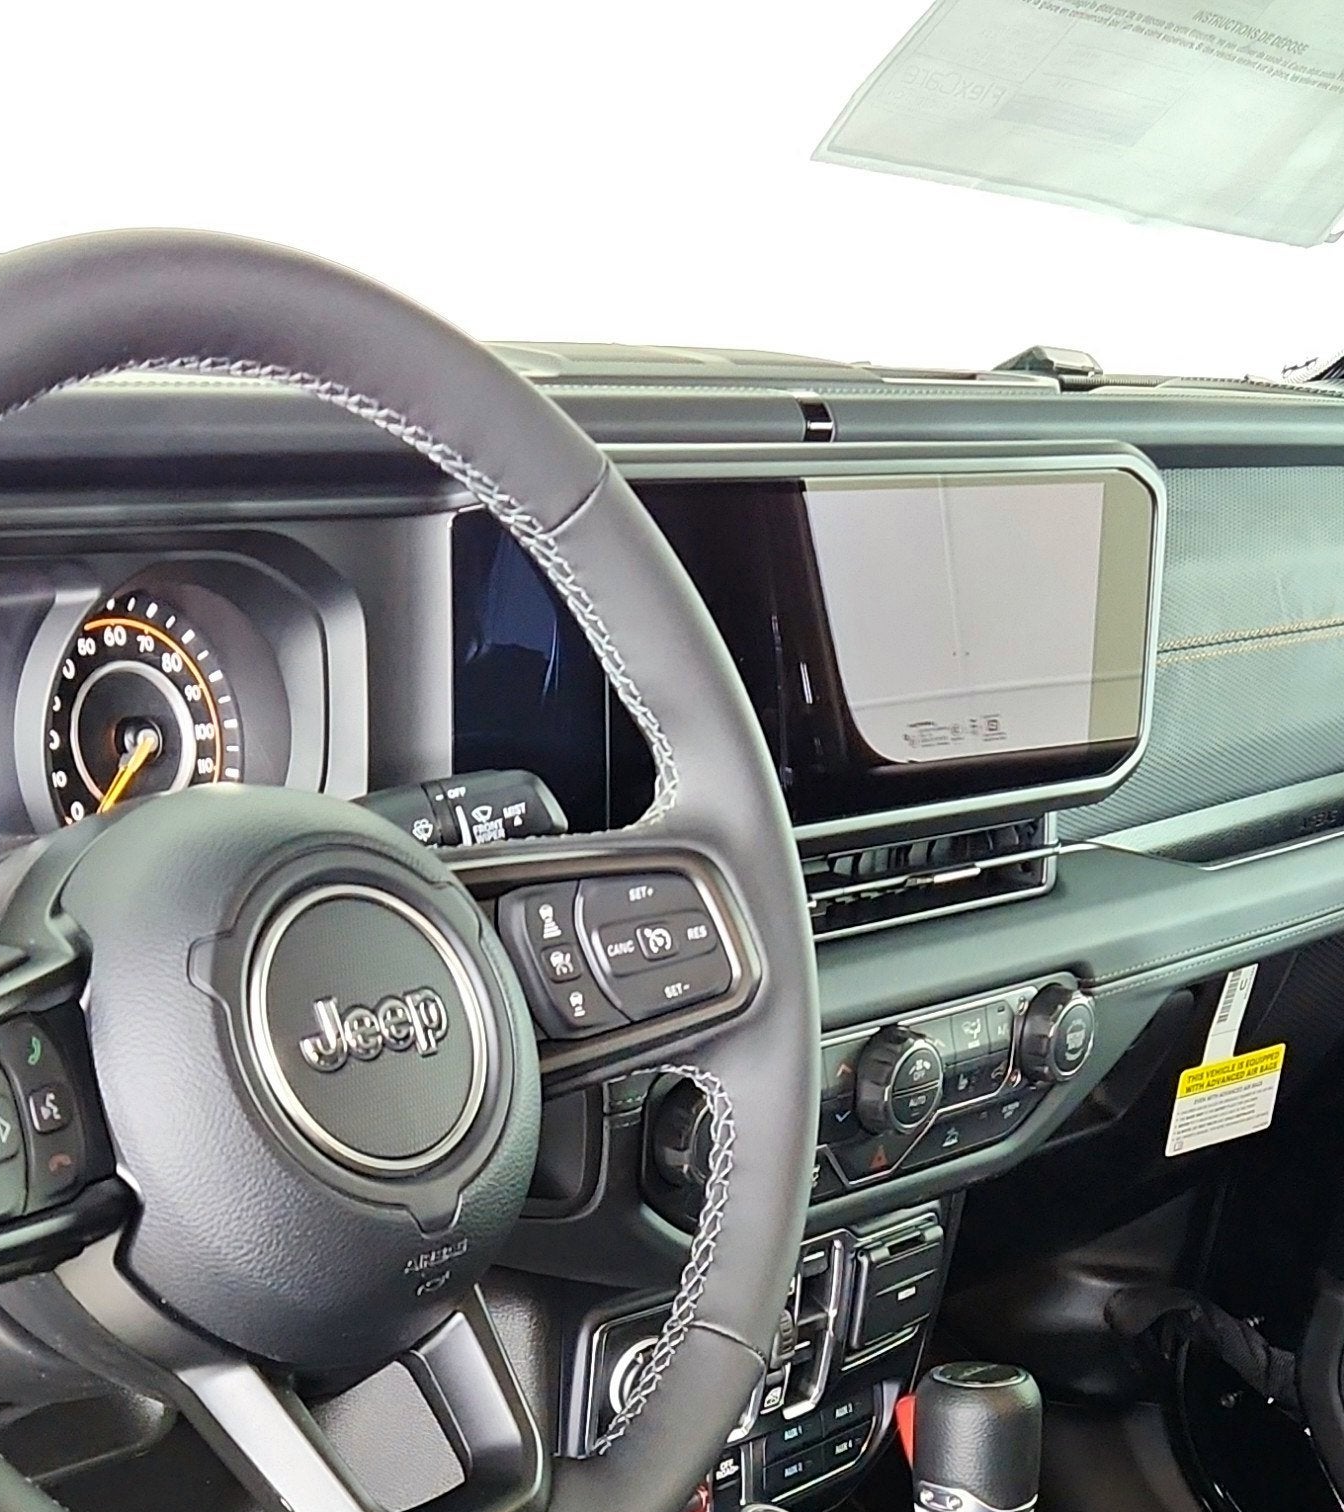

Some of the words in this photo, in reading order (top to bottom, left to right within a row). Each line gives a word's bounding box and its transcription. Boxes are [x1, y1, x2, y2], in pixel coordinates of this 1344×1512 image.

[1192, 9, 1261, 40] INSTRUCTIONS
[103, 625, 127, 647] 60
[137, 635, 154, 653] 70
[77, 637, 96, 656] 50
[161, 653, 183, 673] 80
[184, 684, 201, 701] 90
[194, 723, 214, 740] 100
[197, 757, 214, 775] 110
[52, 770, 67, 788] 10
[70, 801, 85, 821] 0
[687, 925, 707, 940] RES
[299, 985, 449, 1073] Jeep
[1188, 1071, 1204, 1084] THIS
[1205, 1063, 1236, 1079] VEHICLE
[1237, 1060, 1244, 1070] IS
[1245, 1051, 1280, 1068] EQUIPPED
[1185, 1081, 1205, 1094] WITH
[1205, 1070, 1245, 1088] ADVANCED
[1246, 1067, 1259, 1077] AIR
[1259, 1062, 1277, 1073] BAGS
